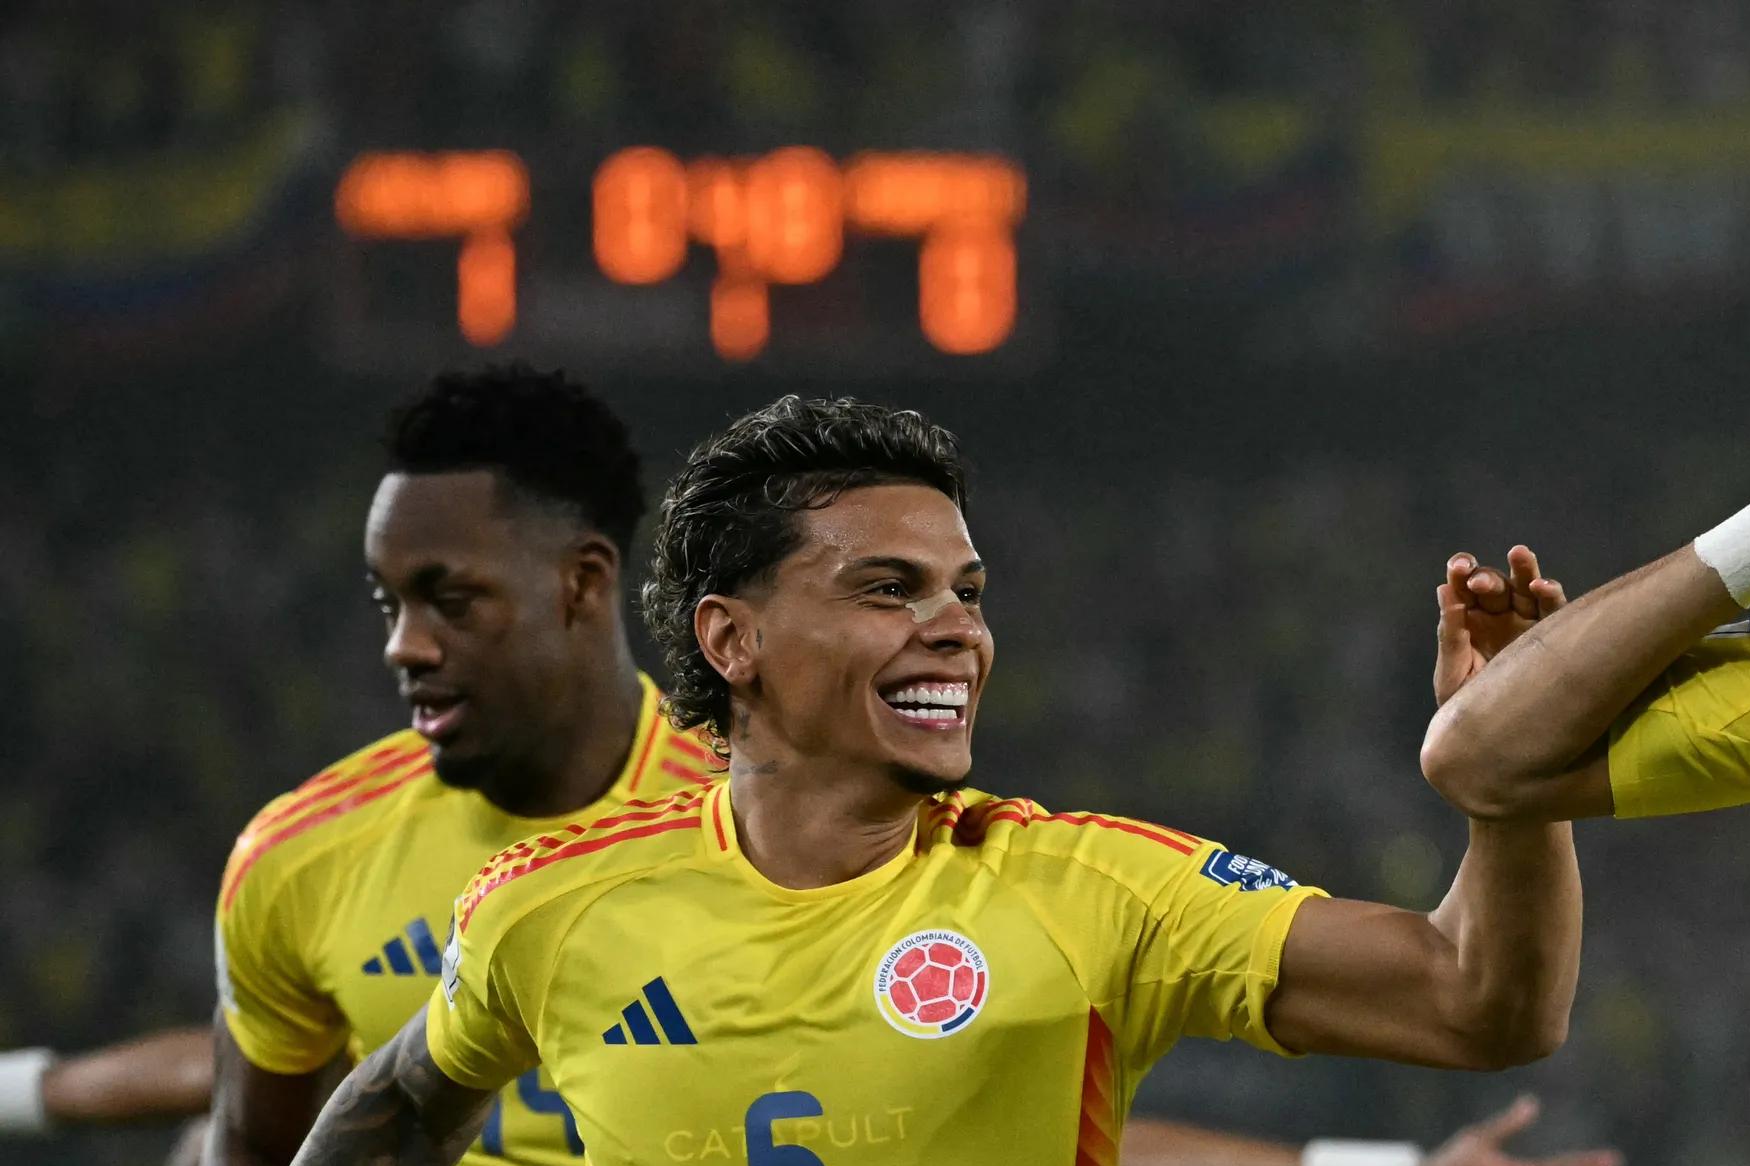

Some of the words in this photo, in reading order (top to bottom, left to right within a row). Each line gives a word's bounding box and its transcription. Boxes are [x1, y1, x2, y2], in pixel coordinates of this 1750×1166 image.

[879, 947, 902, 992] FEDERACION
[901, 933, 954, 949] COLOMBIANA
[955, 938, 965, 947] DE
[963, 943, 984, 970] FUTBOL
